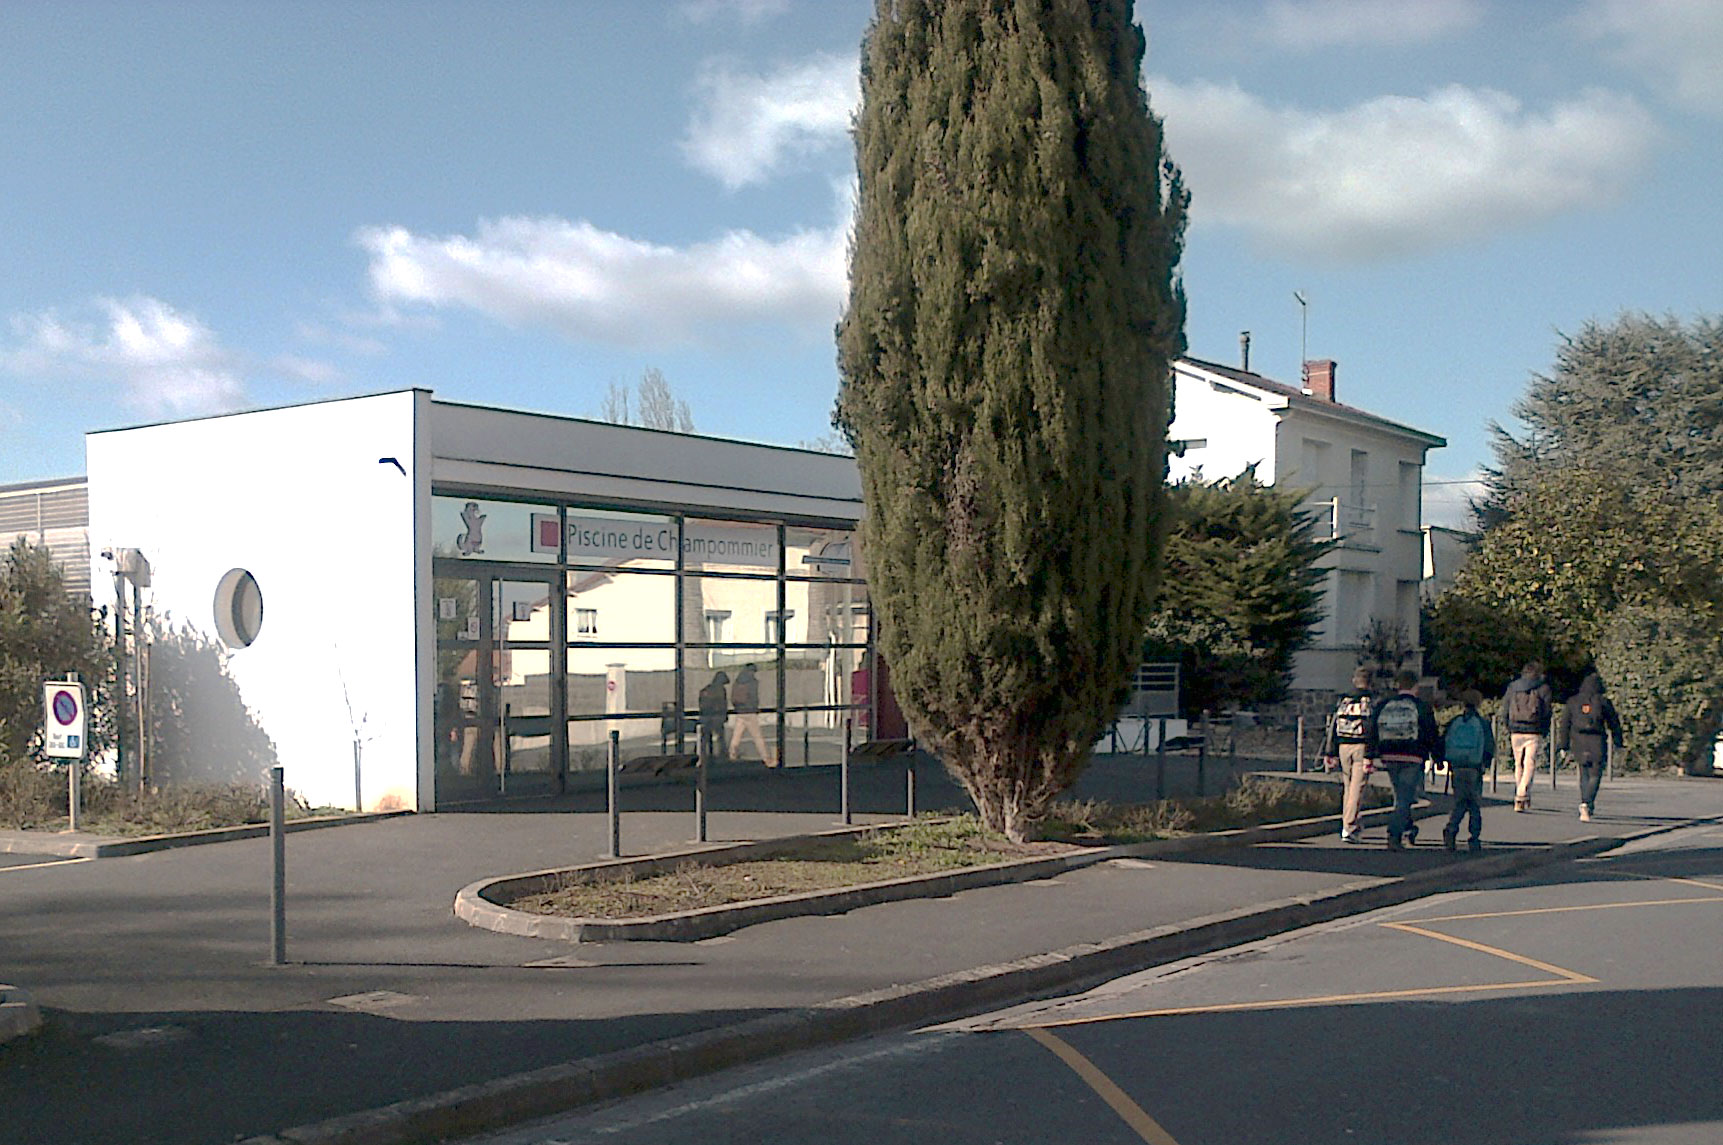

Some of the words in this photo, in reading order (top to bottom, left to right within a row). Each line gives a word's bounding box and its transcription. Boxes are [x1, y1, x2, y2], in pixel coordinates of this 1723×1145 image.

[568, 523, 628, 549] Piscine
[632, 527, 653, 550] de
[657, 530, 773, 559] Champommier
